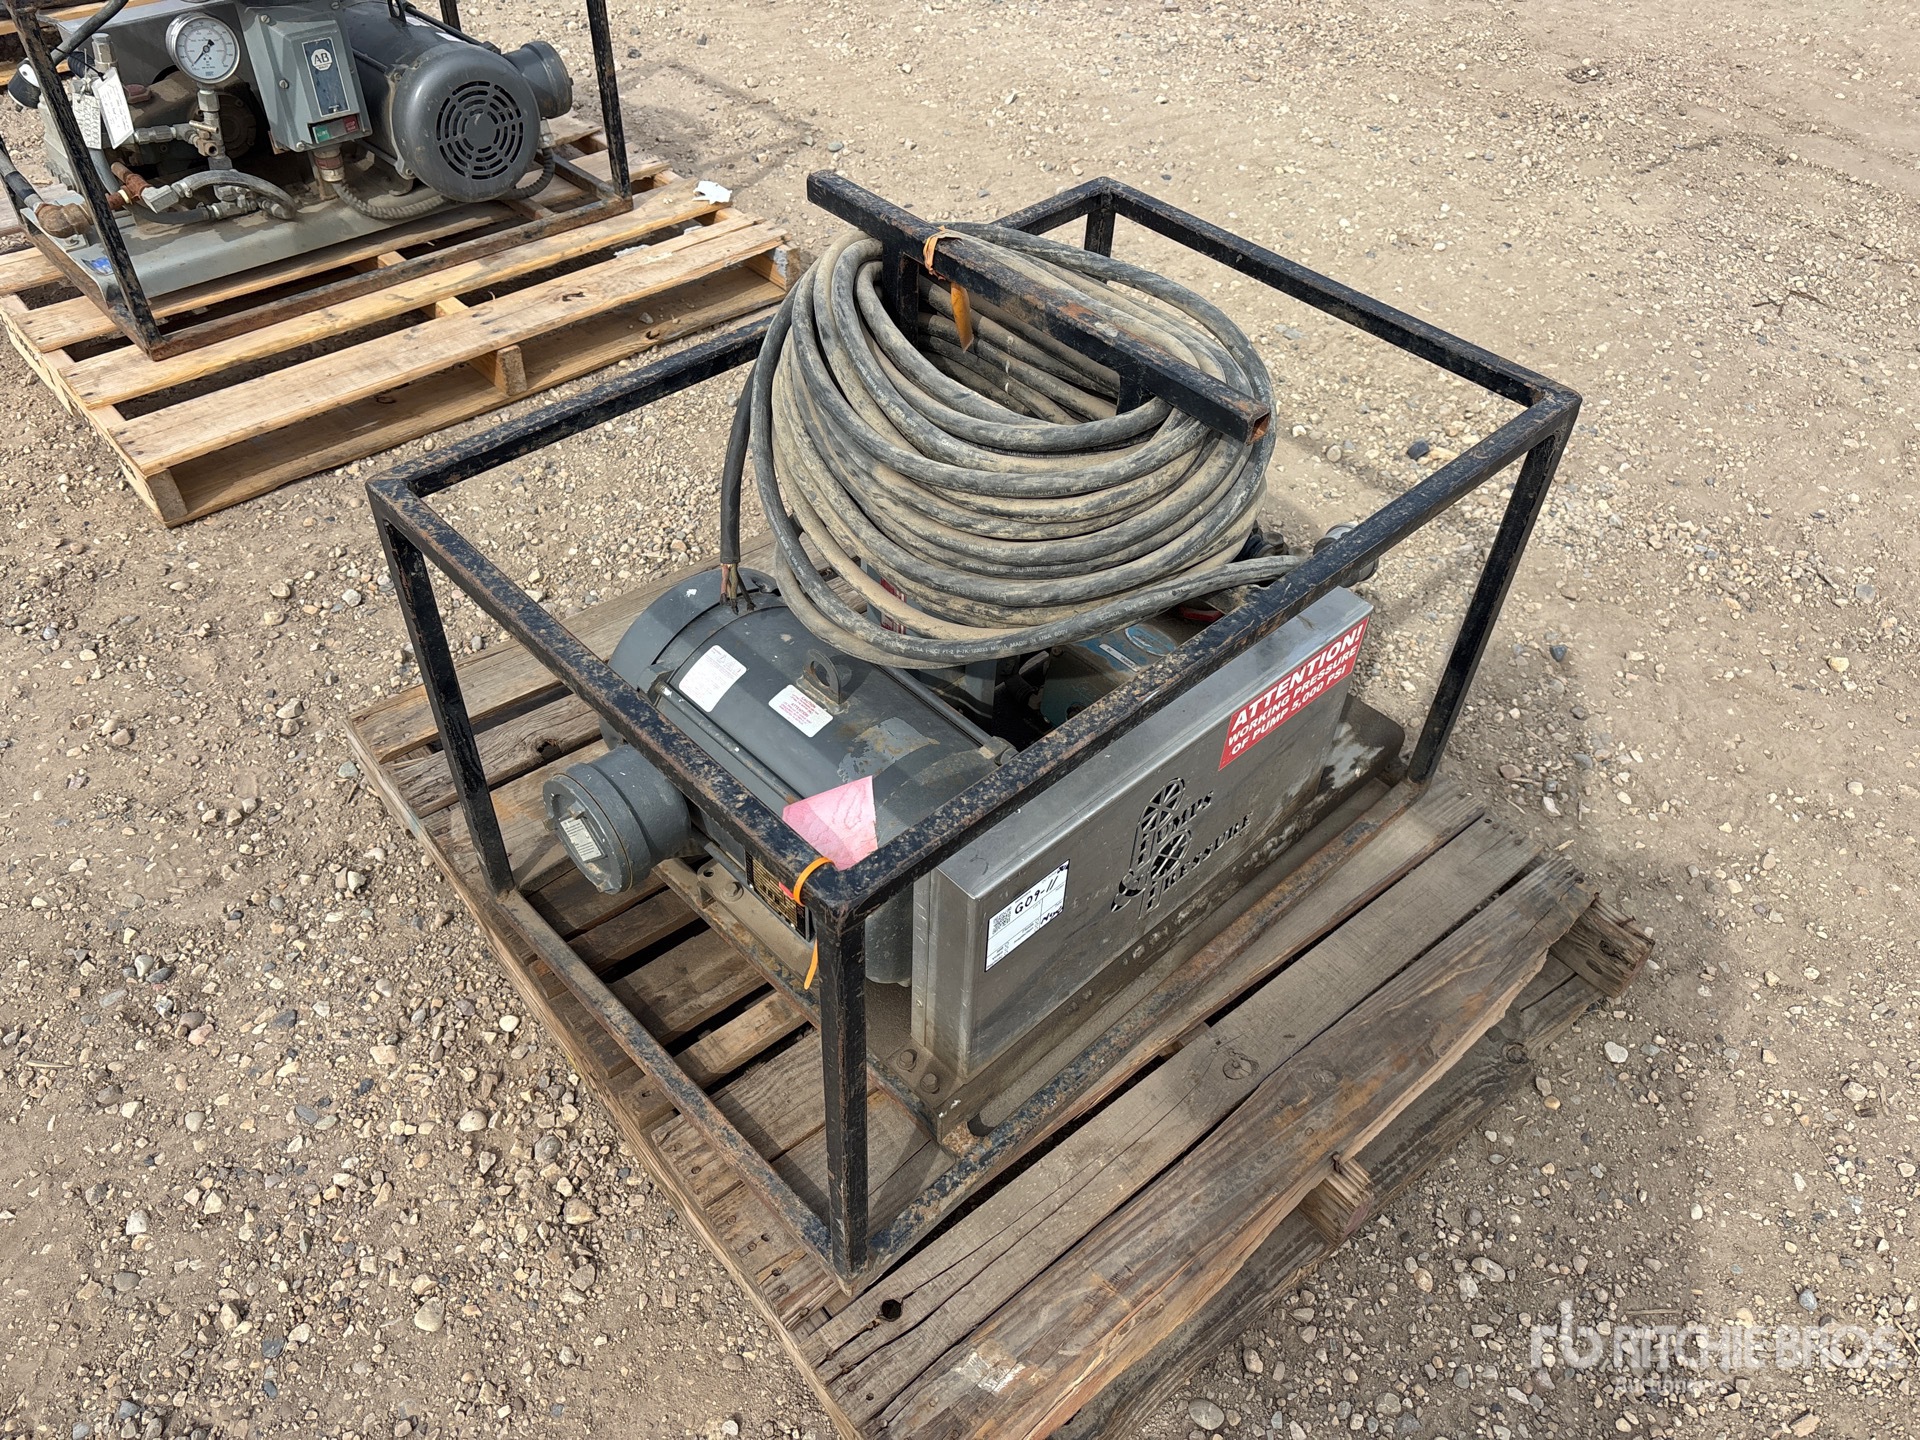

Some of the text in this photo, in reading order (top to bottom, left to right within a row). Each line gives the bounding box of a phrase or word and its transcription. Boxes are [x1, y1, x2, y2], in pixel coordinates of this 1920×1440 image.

[314, 53, 329, 64] AB
[1038, 634, 1052, 642] USA
[1231, 624, 1364, 732] ATTENTION!
[1228, 645, 1357, 746] WORKING PRESSURE
[1231, 664, 1347, 755] OF PUMP 5,000 PSI
